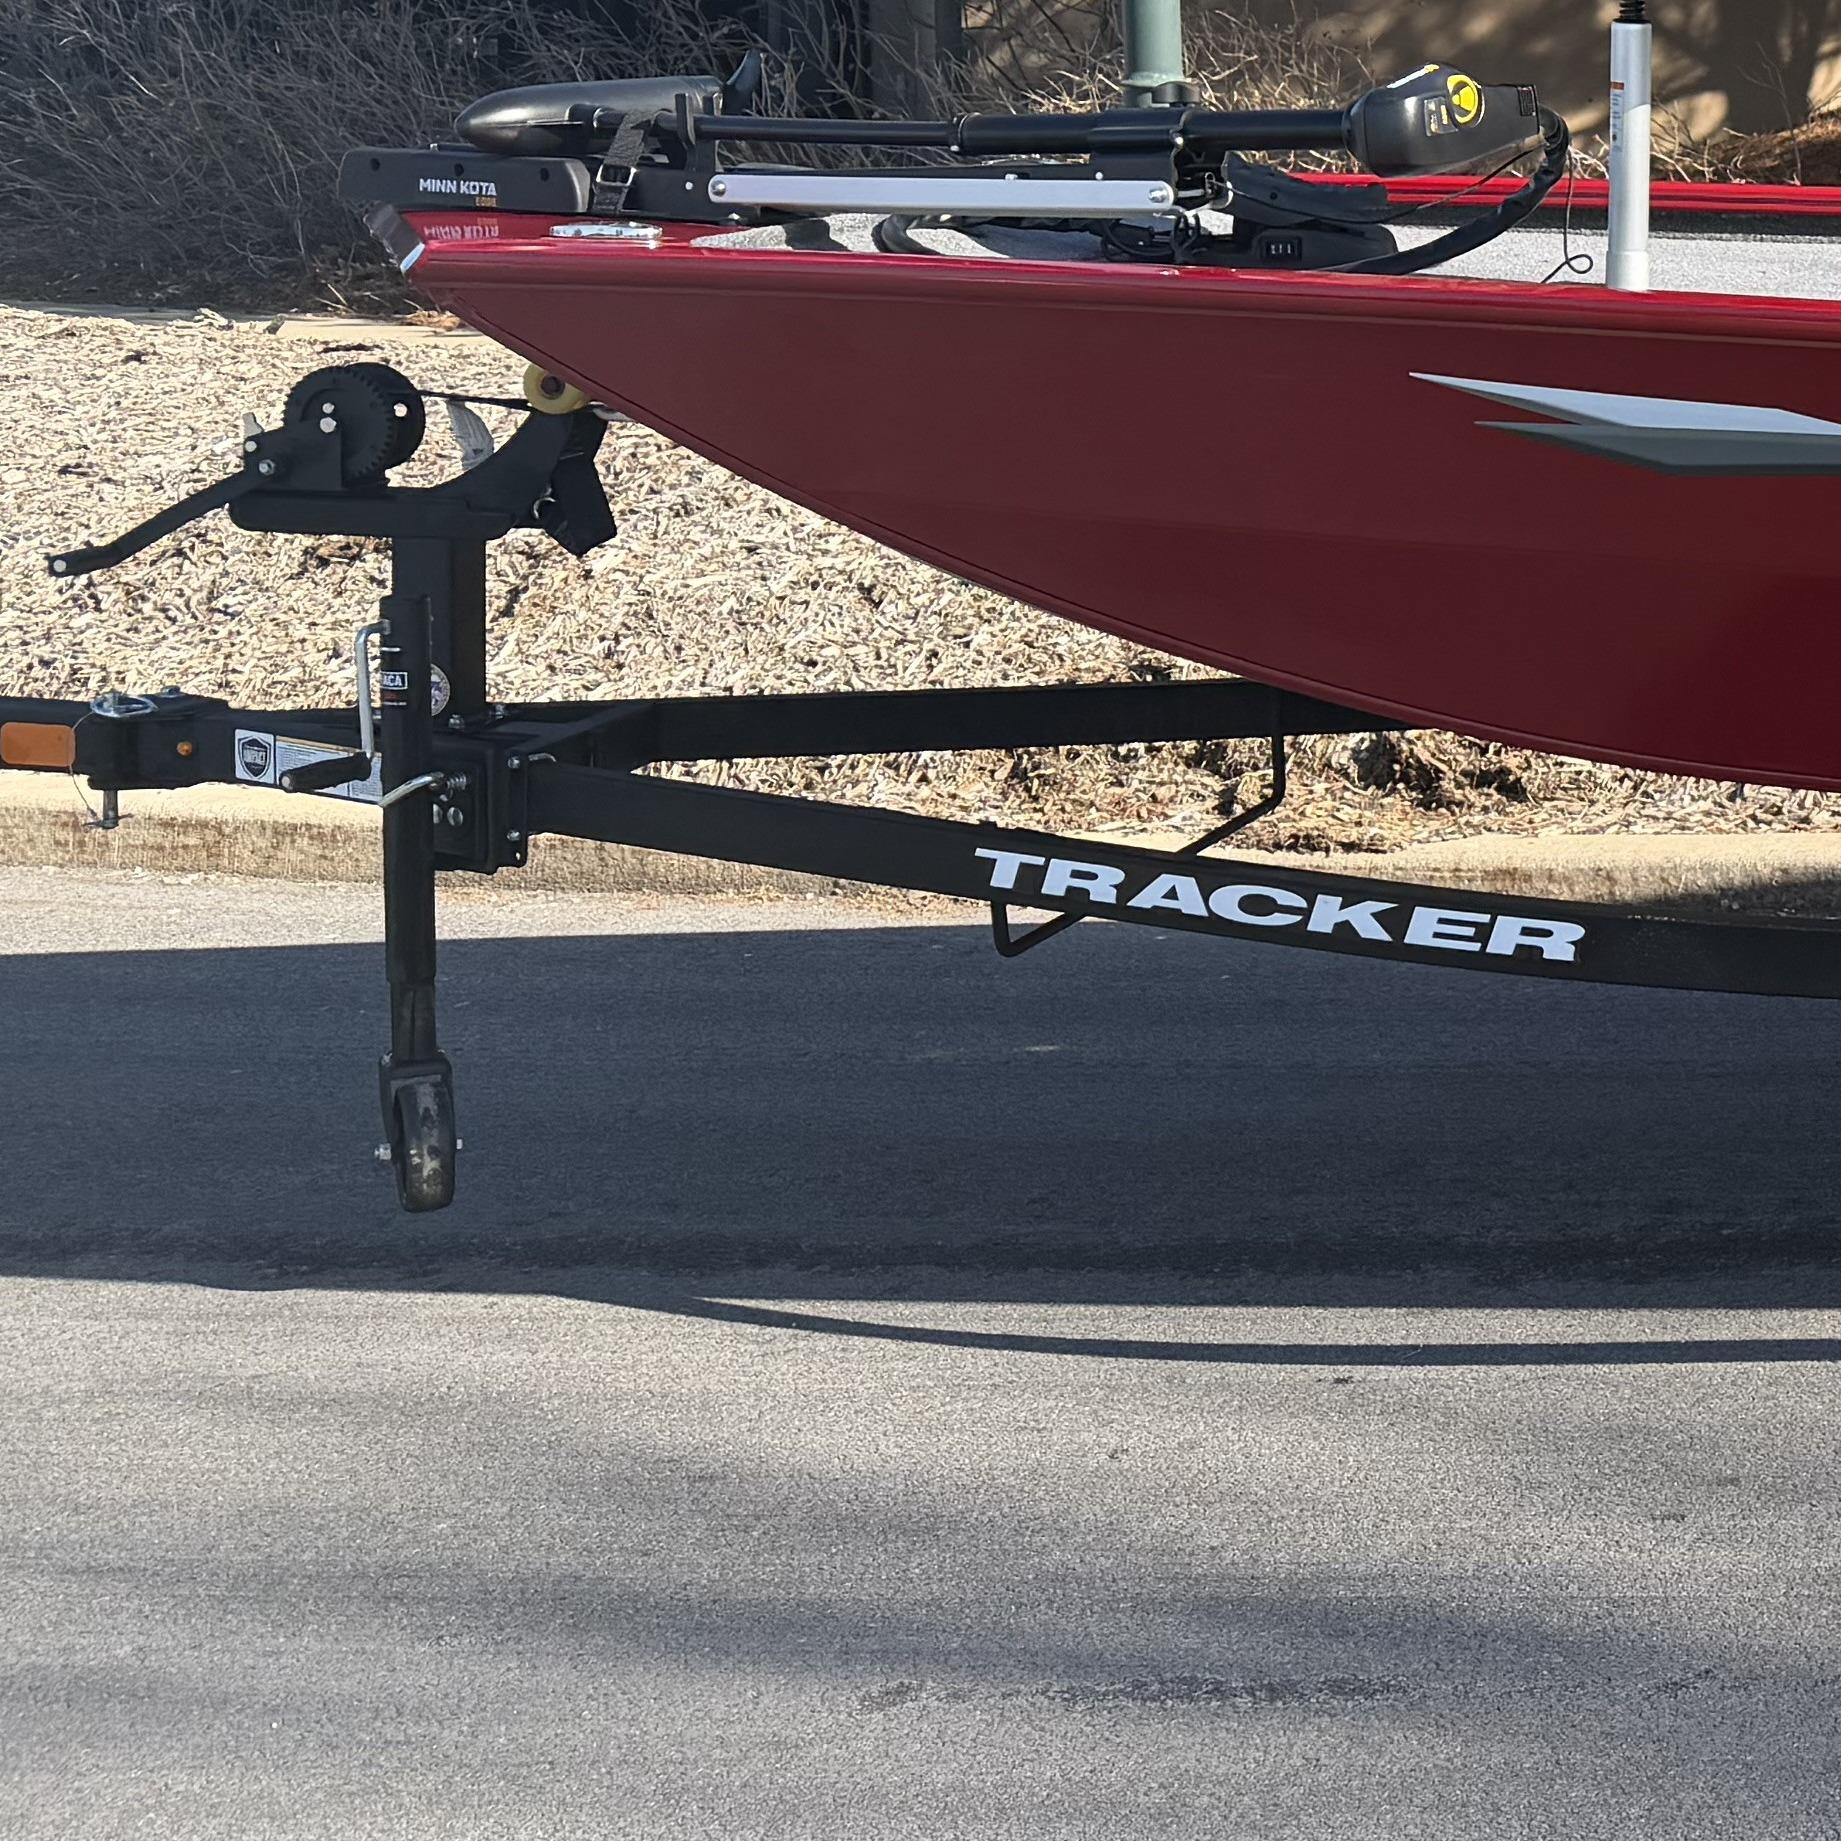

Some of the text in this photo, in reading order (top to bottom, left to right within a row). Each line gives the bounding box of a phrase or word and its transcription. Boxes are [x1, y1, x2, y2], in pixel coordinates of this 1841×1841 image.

[419, 178, 497, 196] MINN KOTA
[974, 847, 1587, 962] TRACKER
